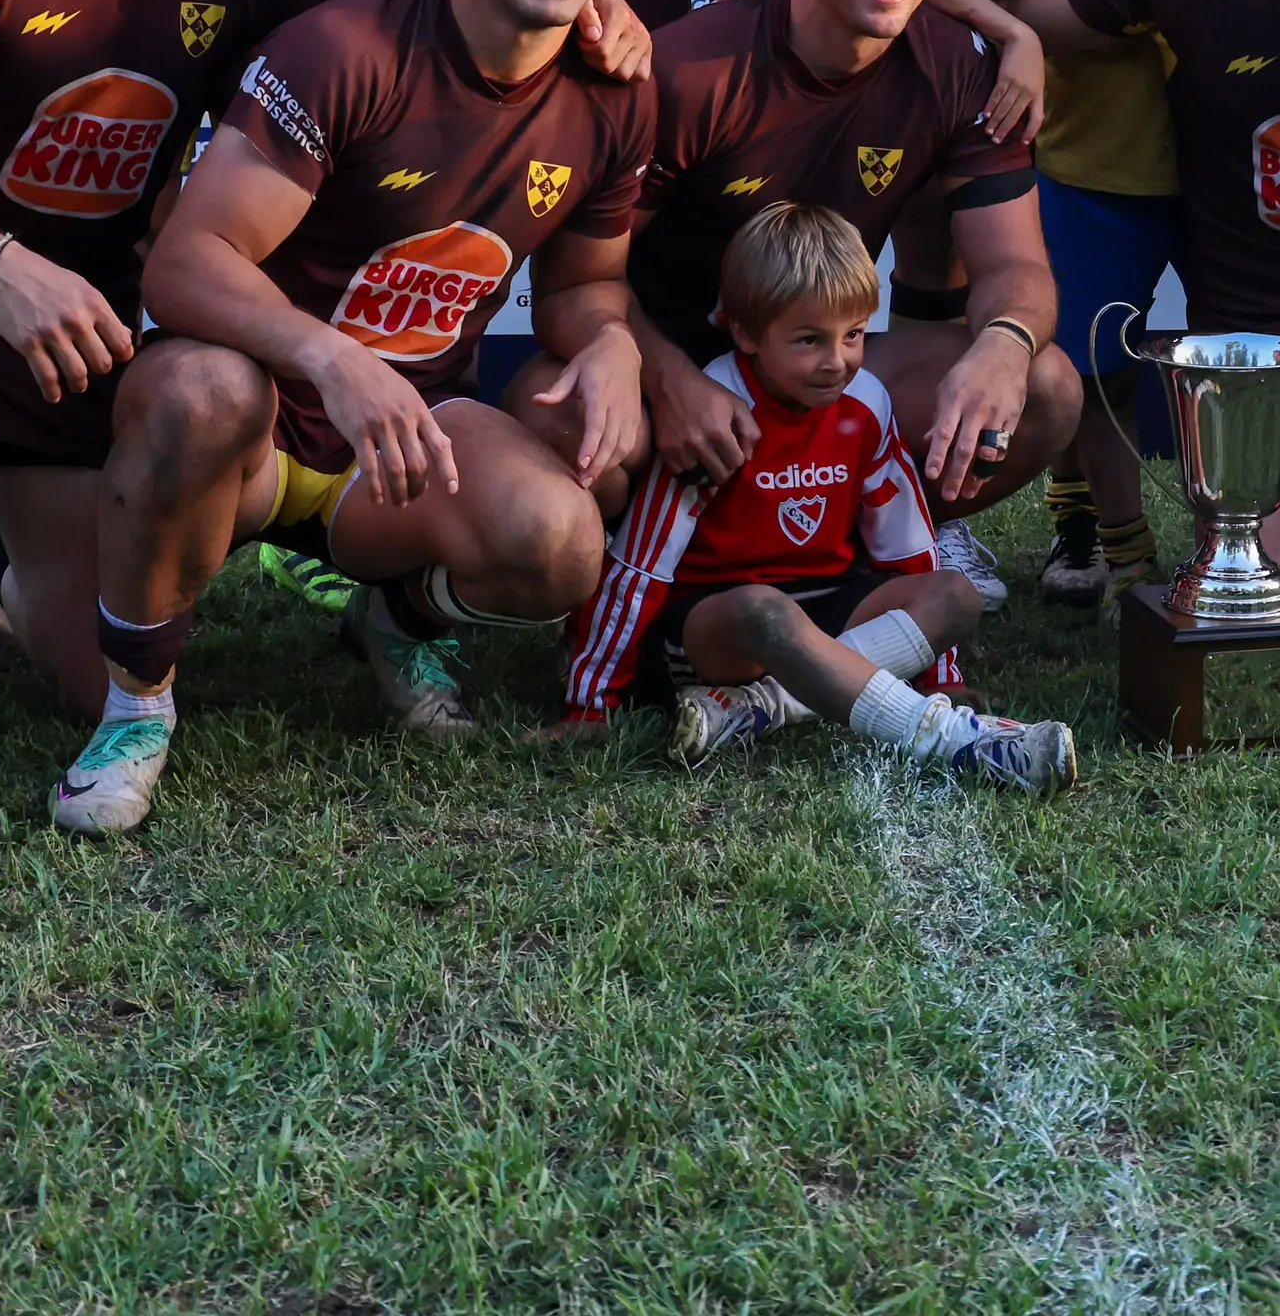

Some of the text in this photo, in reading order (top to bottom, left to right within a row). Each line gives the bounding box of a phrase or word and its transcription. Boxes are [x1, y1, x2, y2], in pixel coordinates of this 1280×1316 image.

[250, 86, 326, 162] ssistance
[258, 68, 326, 145] universal
[11, 141, 153, 191] KING
[363, 259, 496, 308] BURGER
[756, 462, 849, 489] adidas
